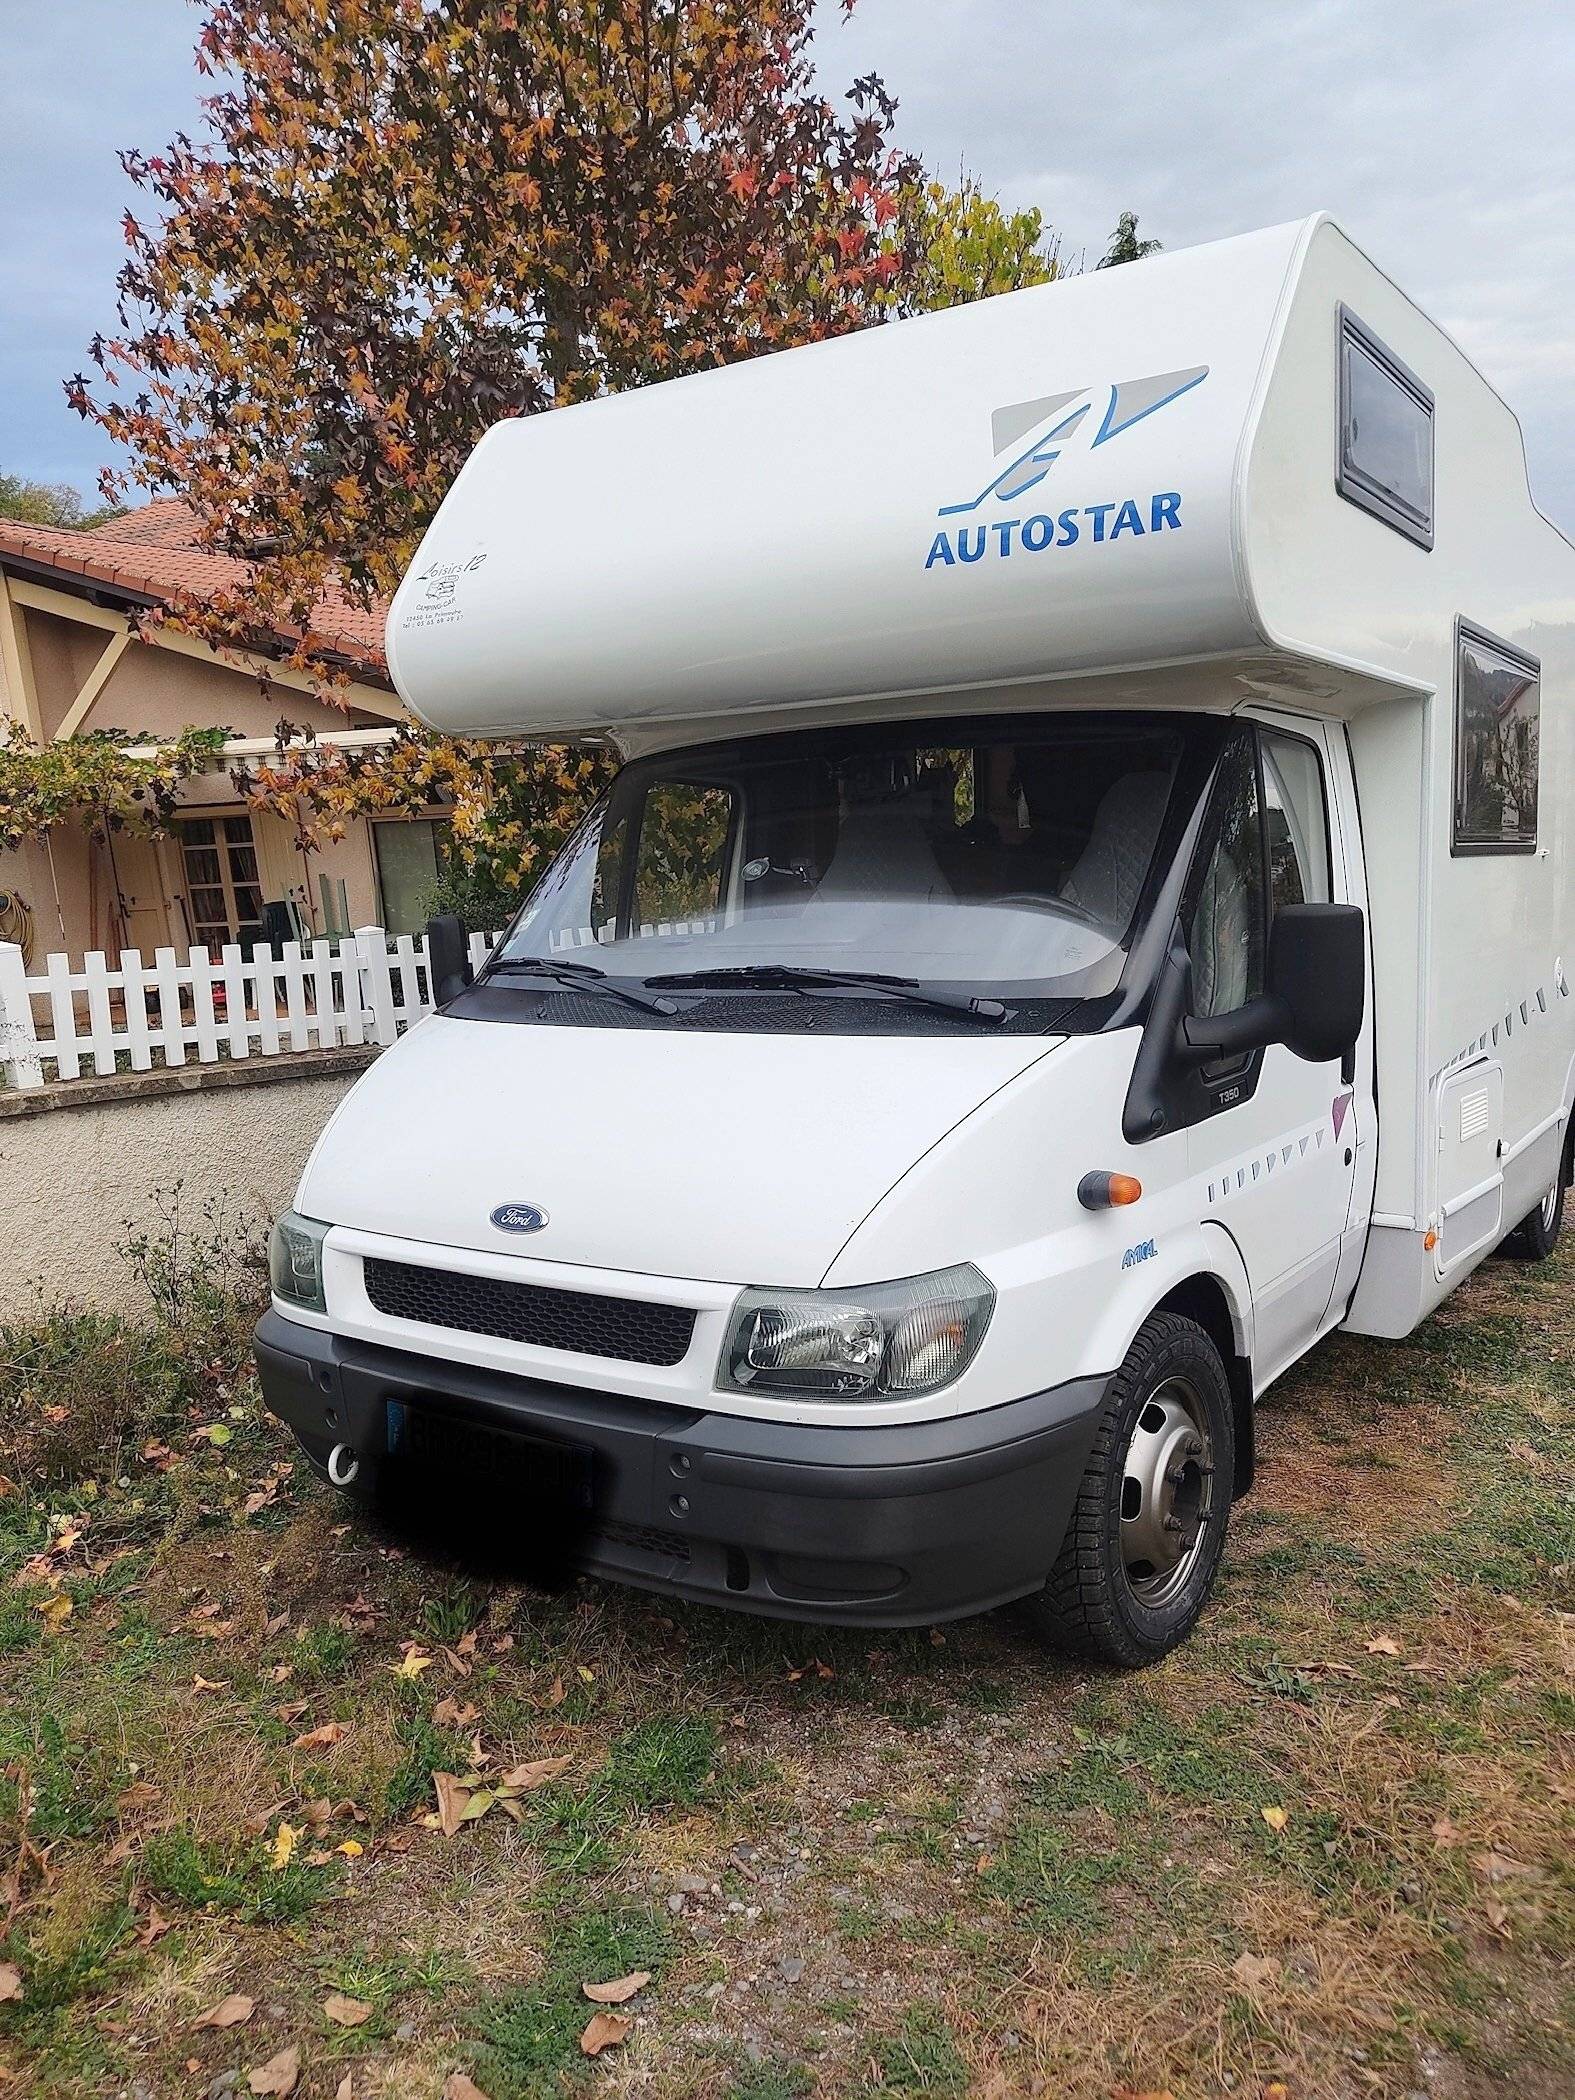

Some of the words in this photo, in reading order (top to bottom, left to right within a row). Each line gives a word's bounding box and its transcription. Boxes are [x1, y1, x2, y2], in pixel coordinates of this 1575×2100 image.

[925, 492, 1184, 569] AUTOSTAR
[1219, 1087, 1240, 1104] T350
[500, 1208, 533, 1226] Ford
